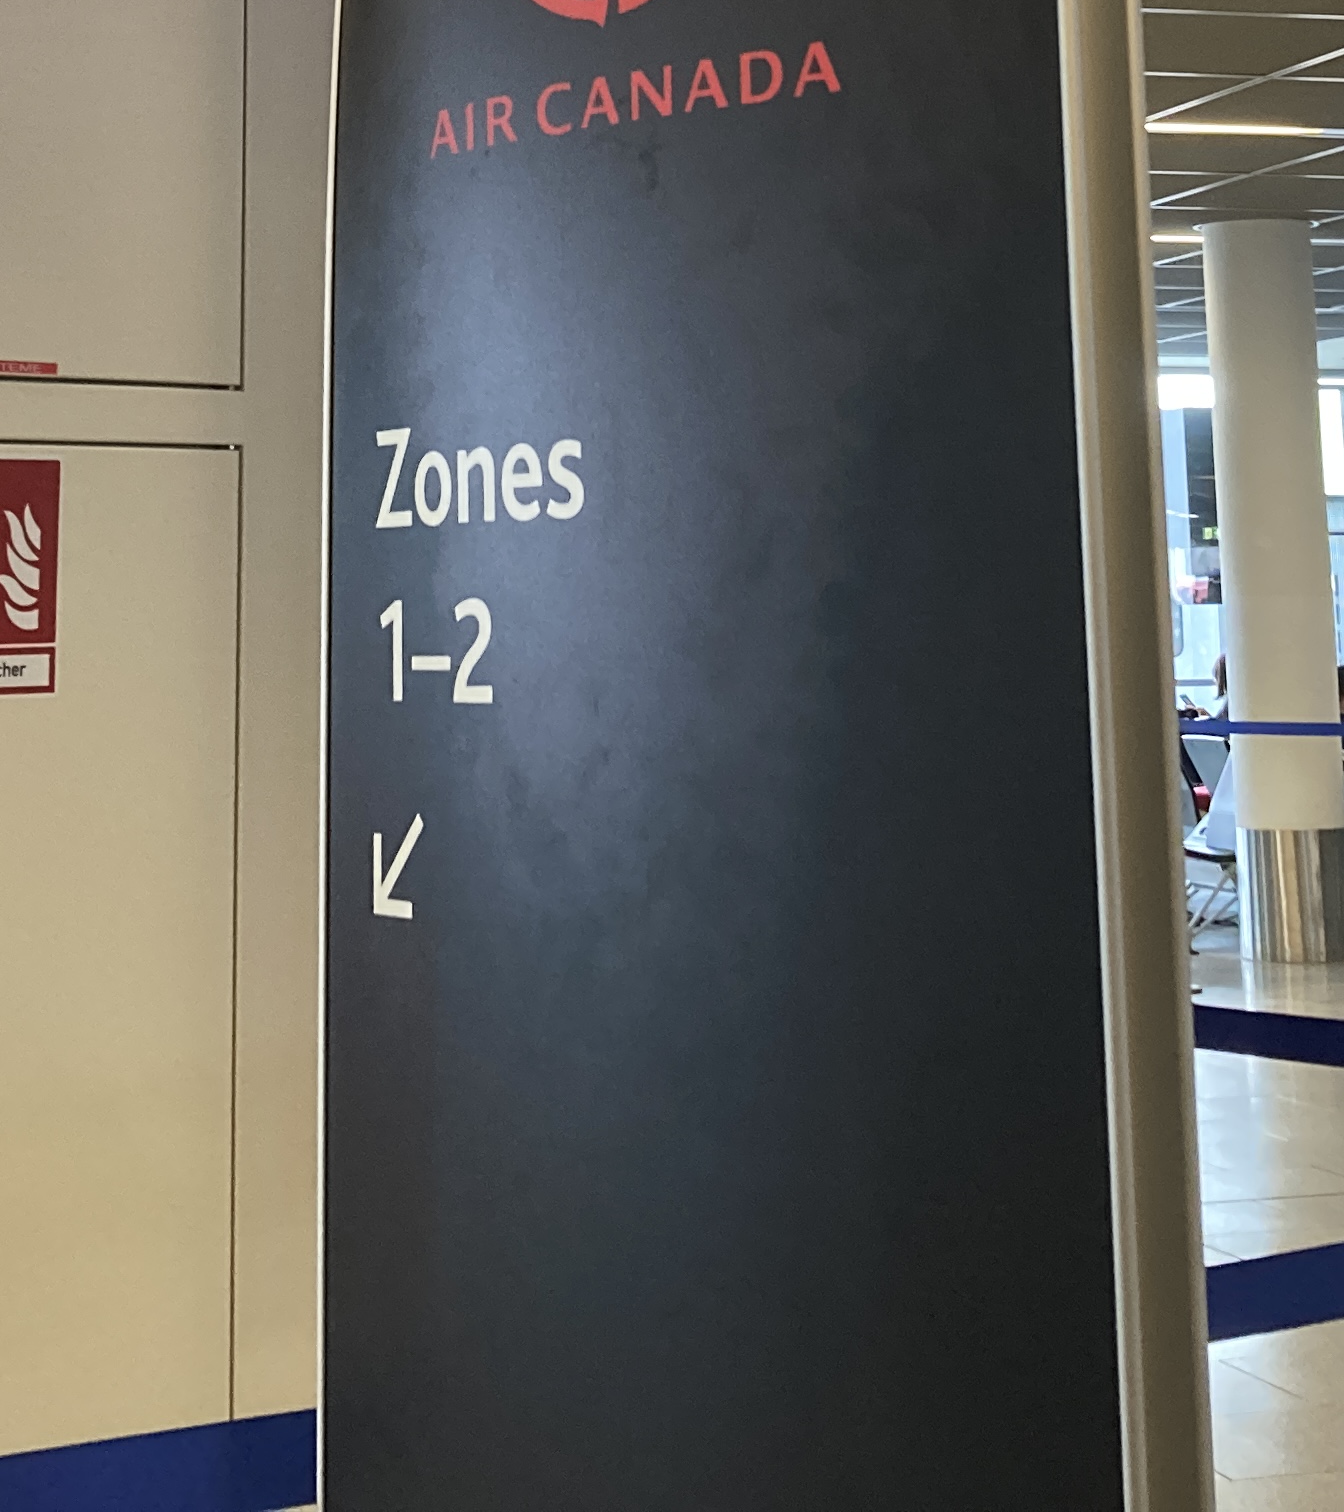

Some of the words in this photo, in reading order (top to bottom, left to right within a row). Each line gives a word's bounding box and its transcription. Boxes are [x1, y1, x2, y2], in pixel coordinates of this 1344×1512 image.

[430, 94, 518, 160] AIR
[535, 40, 842, 136] CANADA
[376, 427, 585, 529] Zones
